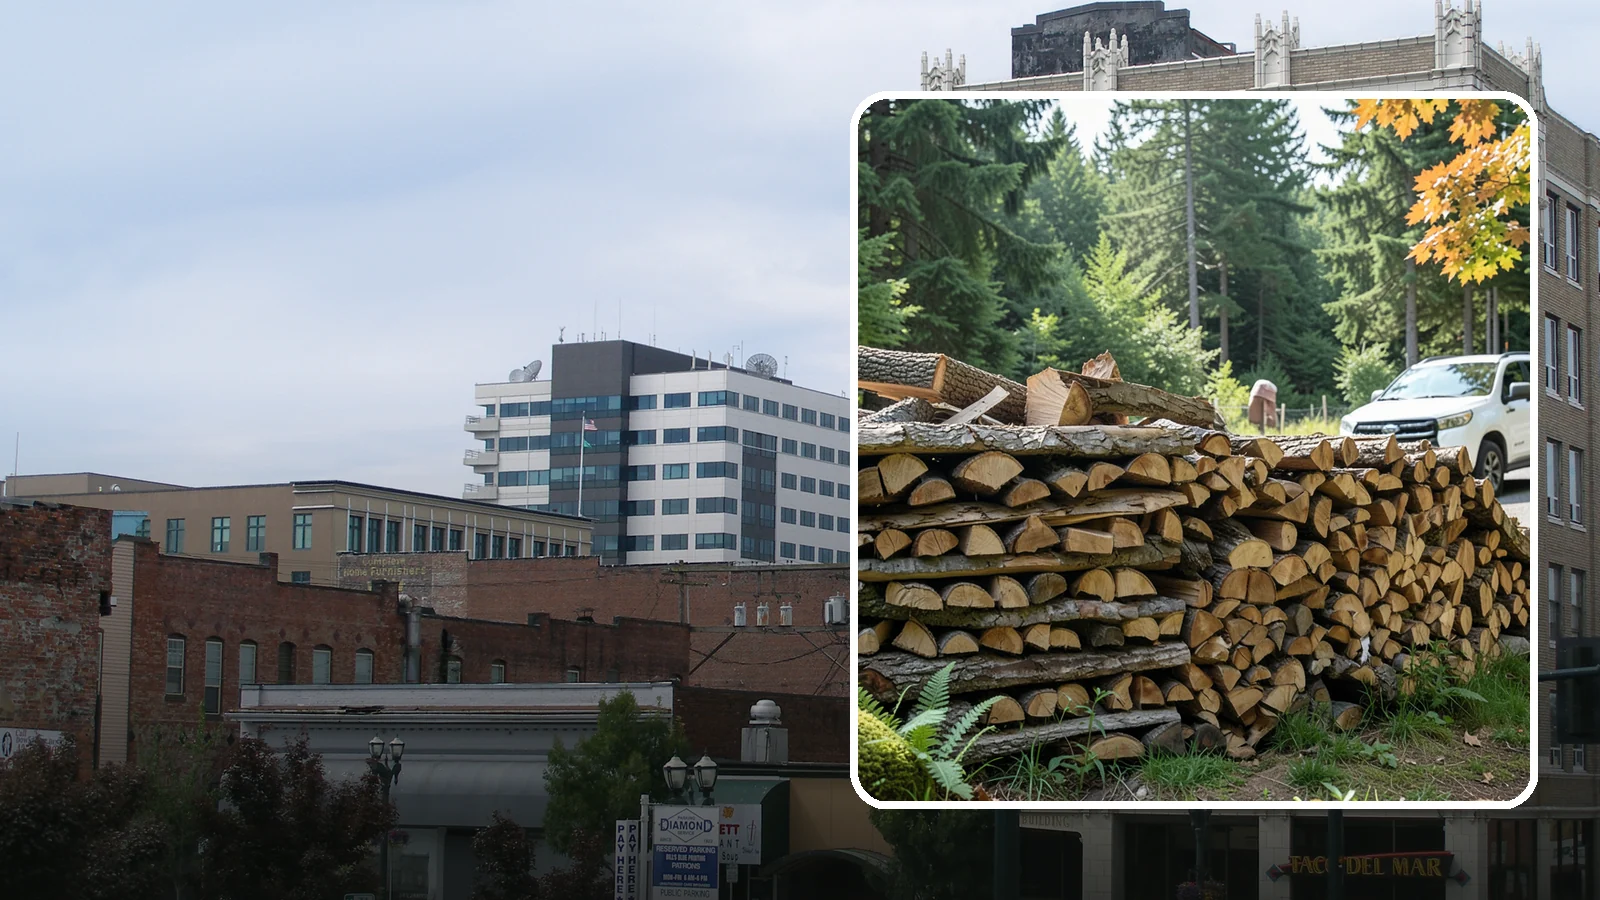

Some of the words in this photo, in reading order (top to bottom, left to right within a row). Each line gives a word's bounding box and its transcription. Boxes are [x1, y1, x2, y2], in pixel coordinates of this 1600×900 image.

[370, 566, 426, 576] Furnishers
[660, 818, 713, 833] DIAMOND
[1022, 815, 1070, 828] BUILDING
[617, 825, 625, 852] PAY
[628, 824, 637, 852] PAY
[655, 845, 688, 853] RESERVED
[689, 846, 716, 854] PARKING
[722, 851, 739, 862] Soup
[671, 862, 701, 870] PATRONS
[1346, 856, 1385, 876] DEL
[1392, 857, 1442, 877] MAR
[616, 856, 625, 894] HERE
[627, 855, 636, 894] HERE
[660, 888, 681, 897] PUBLIC
[683, 889, 710, 898] PARKING
